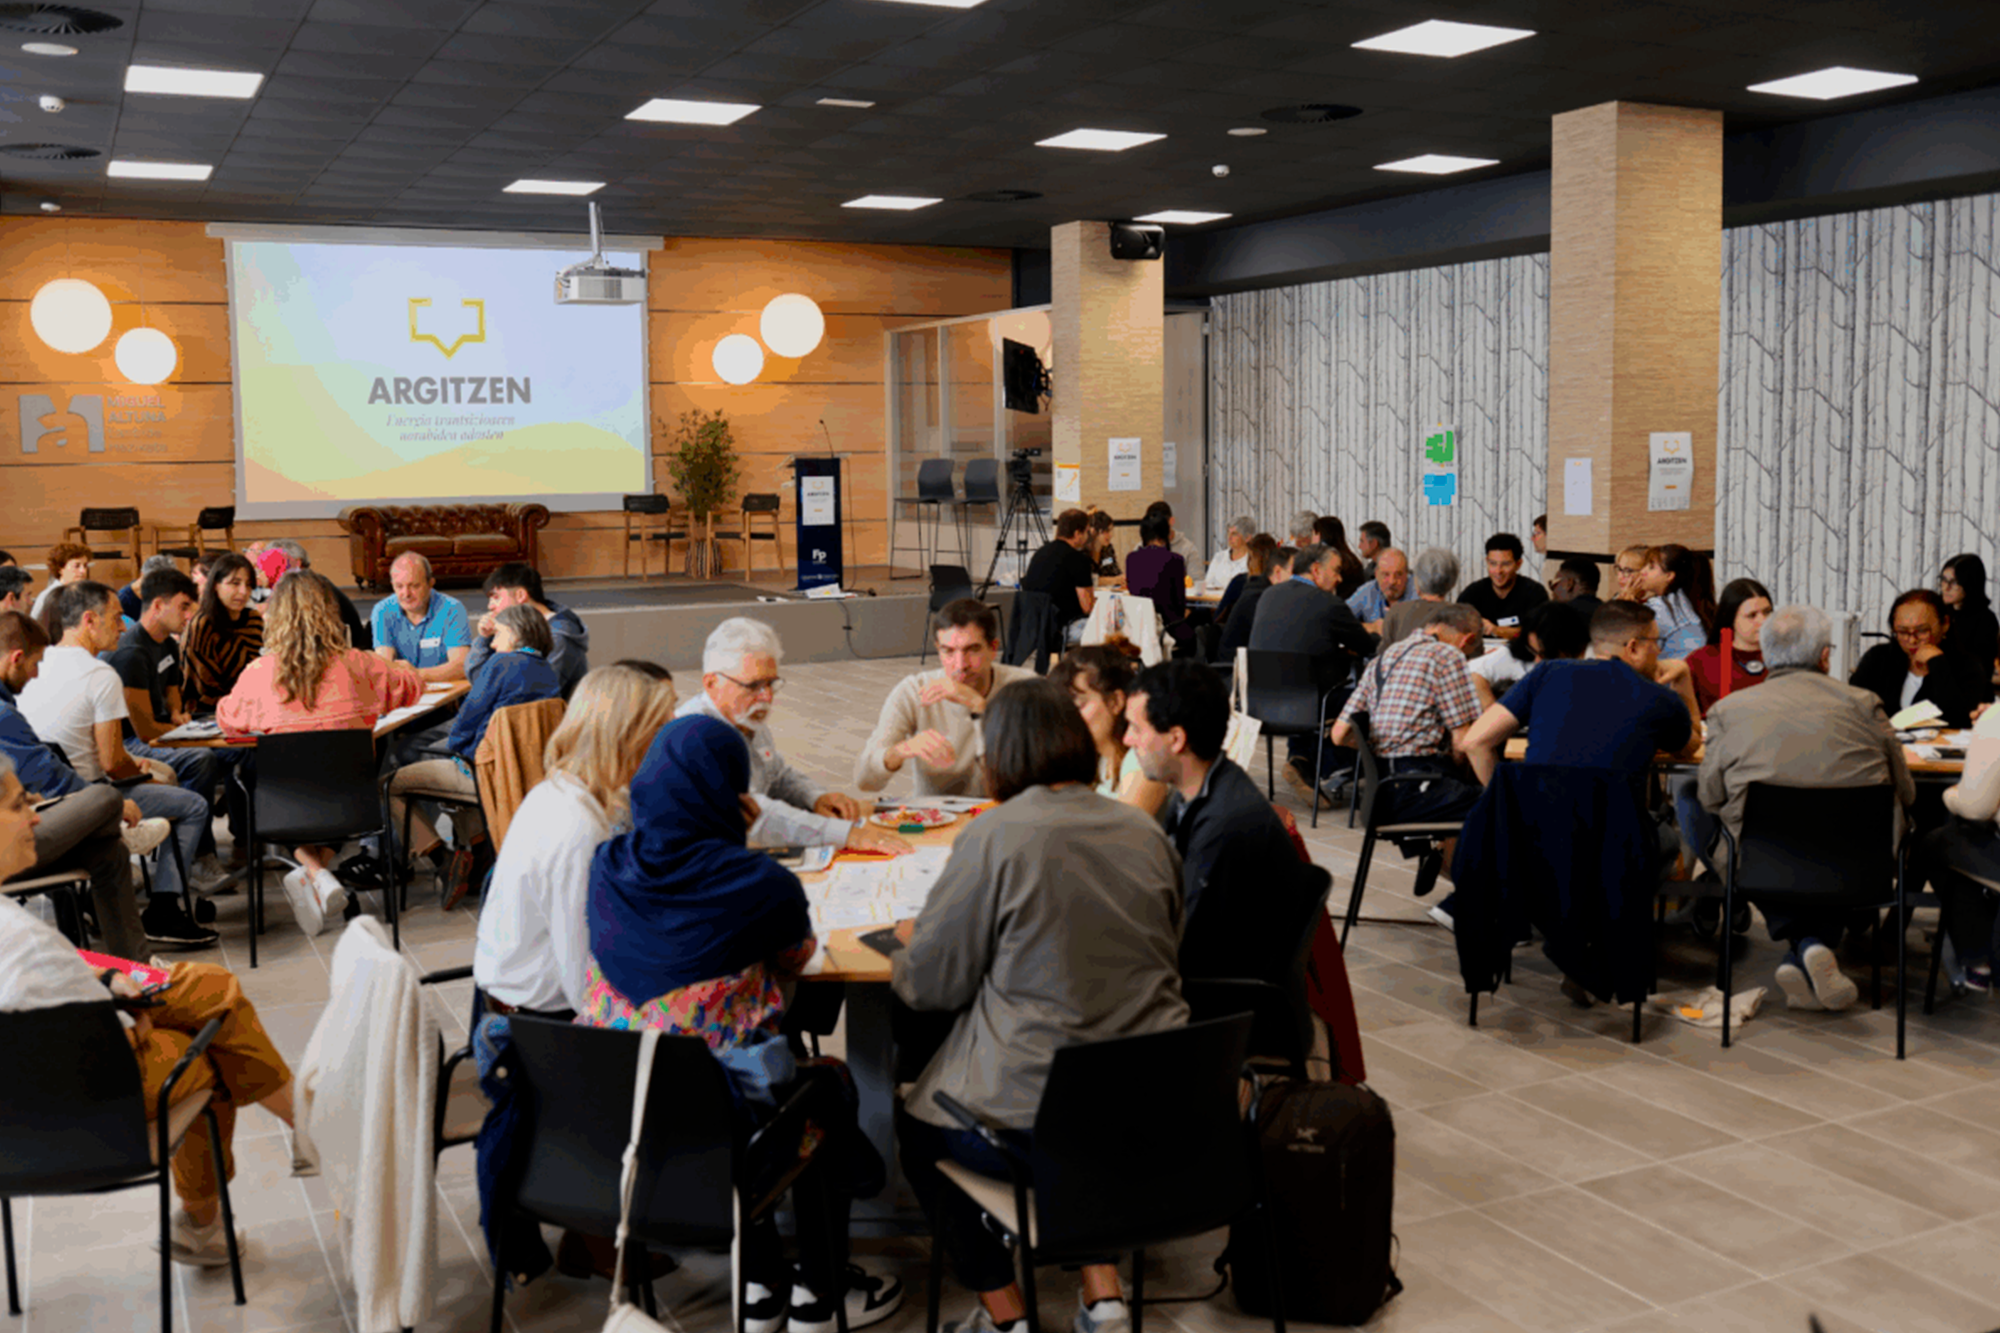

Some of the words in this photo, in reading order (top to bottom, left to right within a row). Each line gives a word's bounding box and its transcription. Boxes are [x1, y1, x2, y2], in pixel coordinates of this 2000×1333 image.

[367, 376, 531, 405] ARGITZEN
[107, 395, 166, 408] MIGUEL
[108, 410, 167, 423] ALTUNA
[386, 413, 432, 428] Energia
